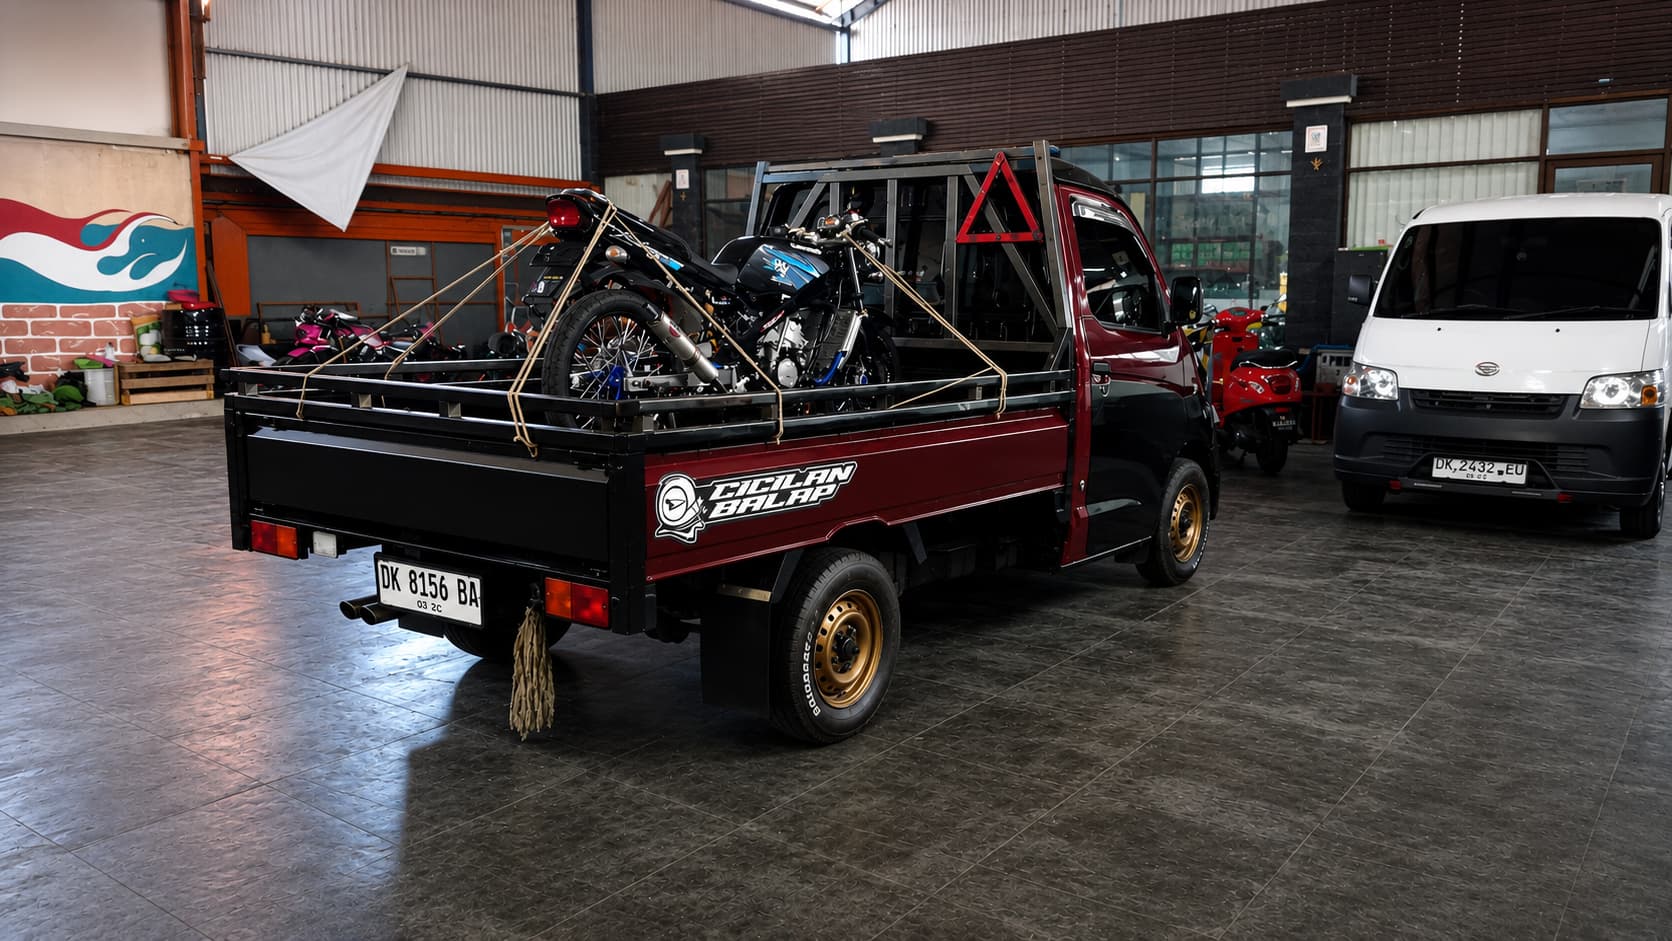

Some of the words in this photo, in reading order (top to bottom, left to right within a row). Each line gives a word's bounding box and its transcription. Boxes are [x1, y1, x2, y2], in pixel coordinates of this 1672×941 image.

[708, 465, 855, 501] CICILAN
[1459, 460, 1495, 474] 2432
[1506, 464, 1525, 476] EU
[708, 483, 837, 519] BALAP
[380, 564, 401, 592] DK
[408, 569, 449, 601] 8156
[457, 578, 480, 608] BA
